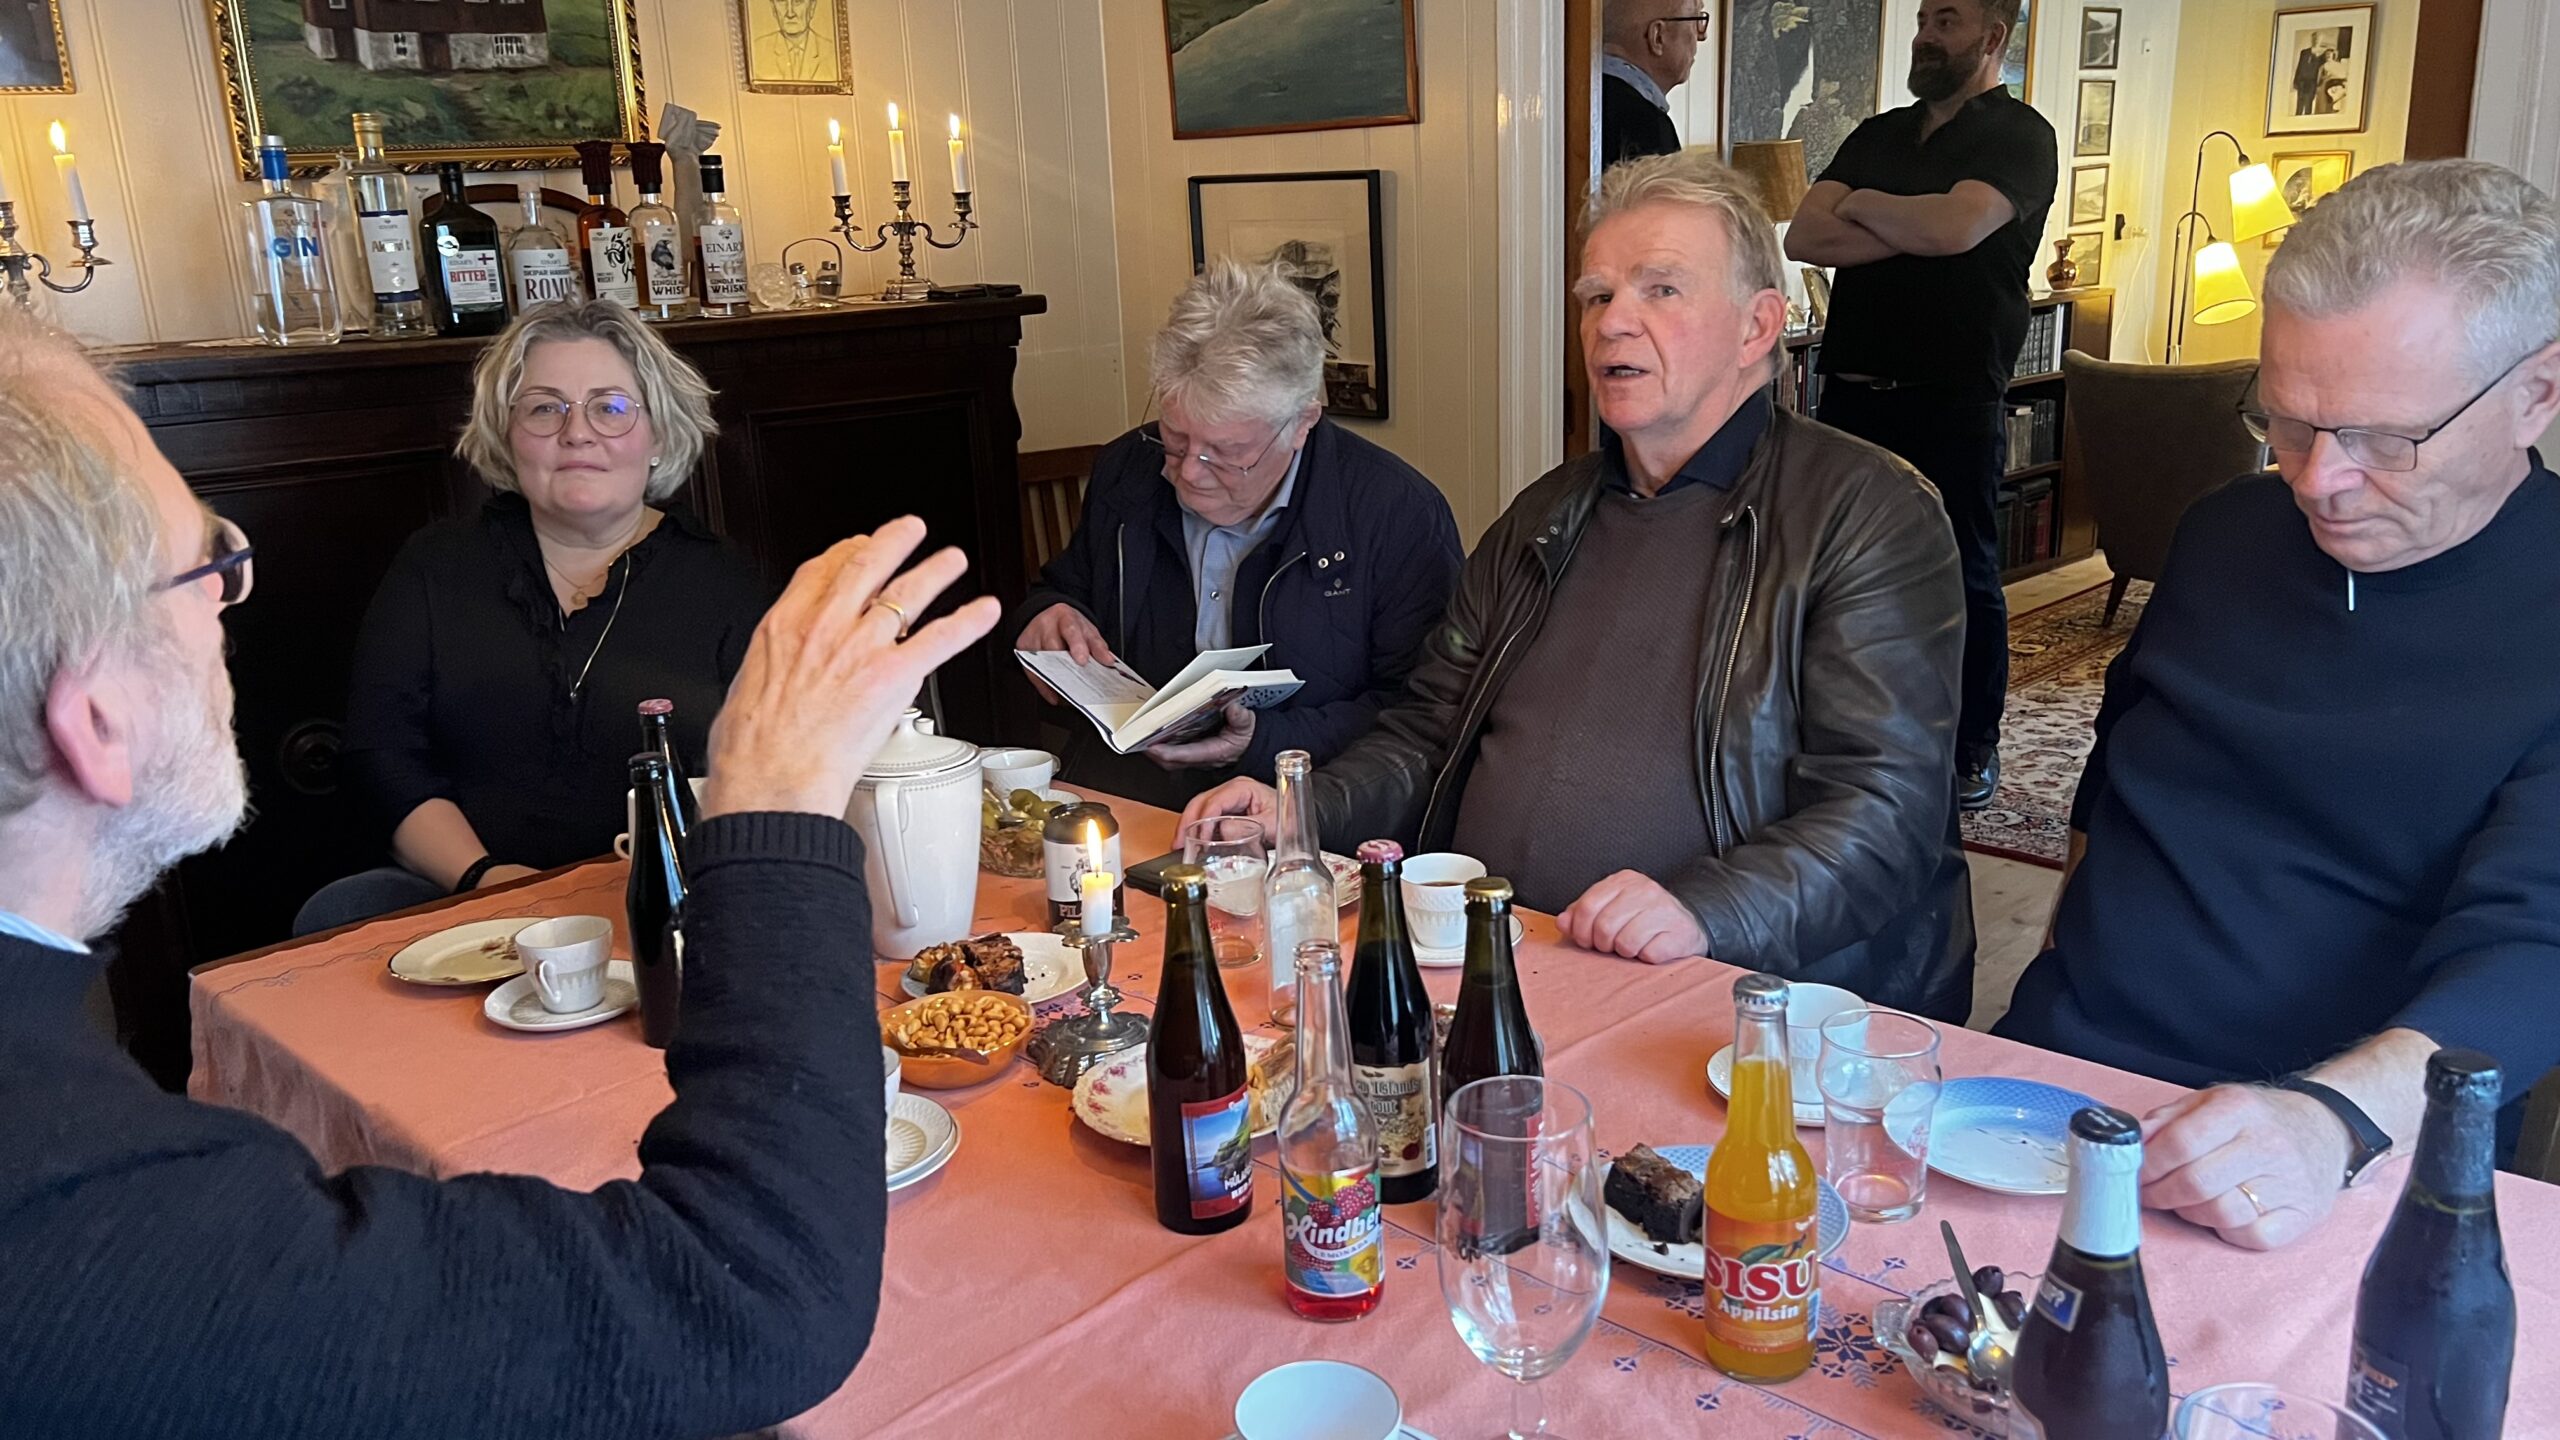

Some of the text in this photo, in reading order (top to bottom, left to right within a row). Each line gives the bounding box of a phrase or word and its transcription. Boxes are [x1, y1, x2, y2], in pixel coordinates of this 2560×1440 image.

[273, 236, 320, 258] GIN
[450, 269, 487, 283] BITTER
[1323, 587, 1351, 598] GANT
[1704, 1246, 1817, 1304] SISU
[1718, 1297, 1800, 1323] Appilsin
